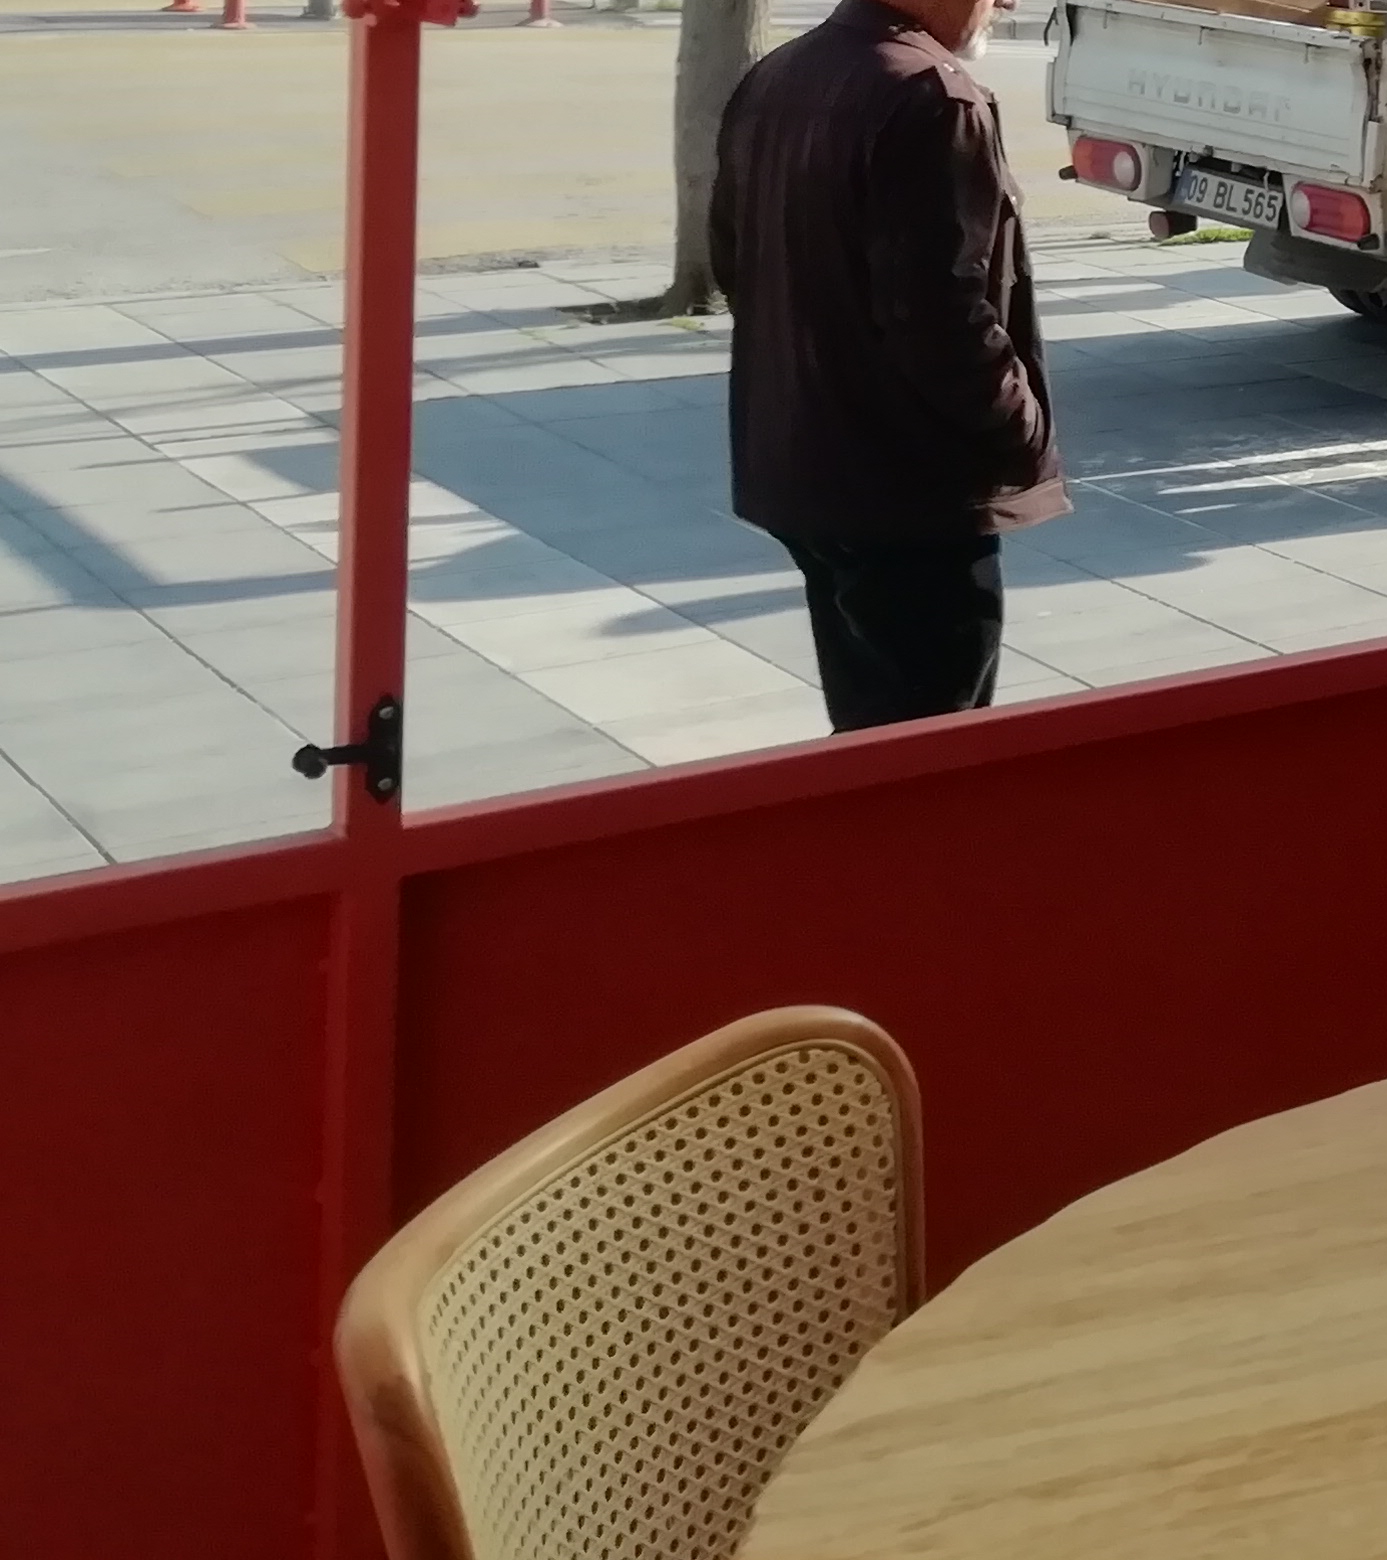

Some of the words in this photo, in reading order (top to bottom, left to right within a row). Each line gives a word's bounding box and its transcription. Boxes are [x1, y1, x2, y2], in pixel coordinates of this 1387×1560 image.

[1186, 175, 1209, 203] 09
[1213, 181, 1238, 213] BL
[1242, 189, 1279, 222] 565
